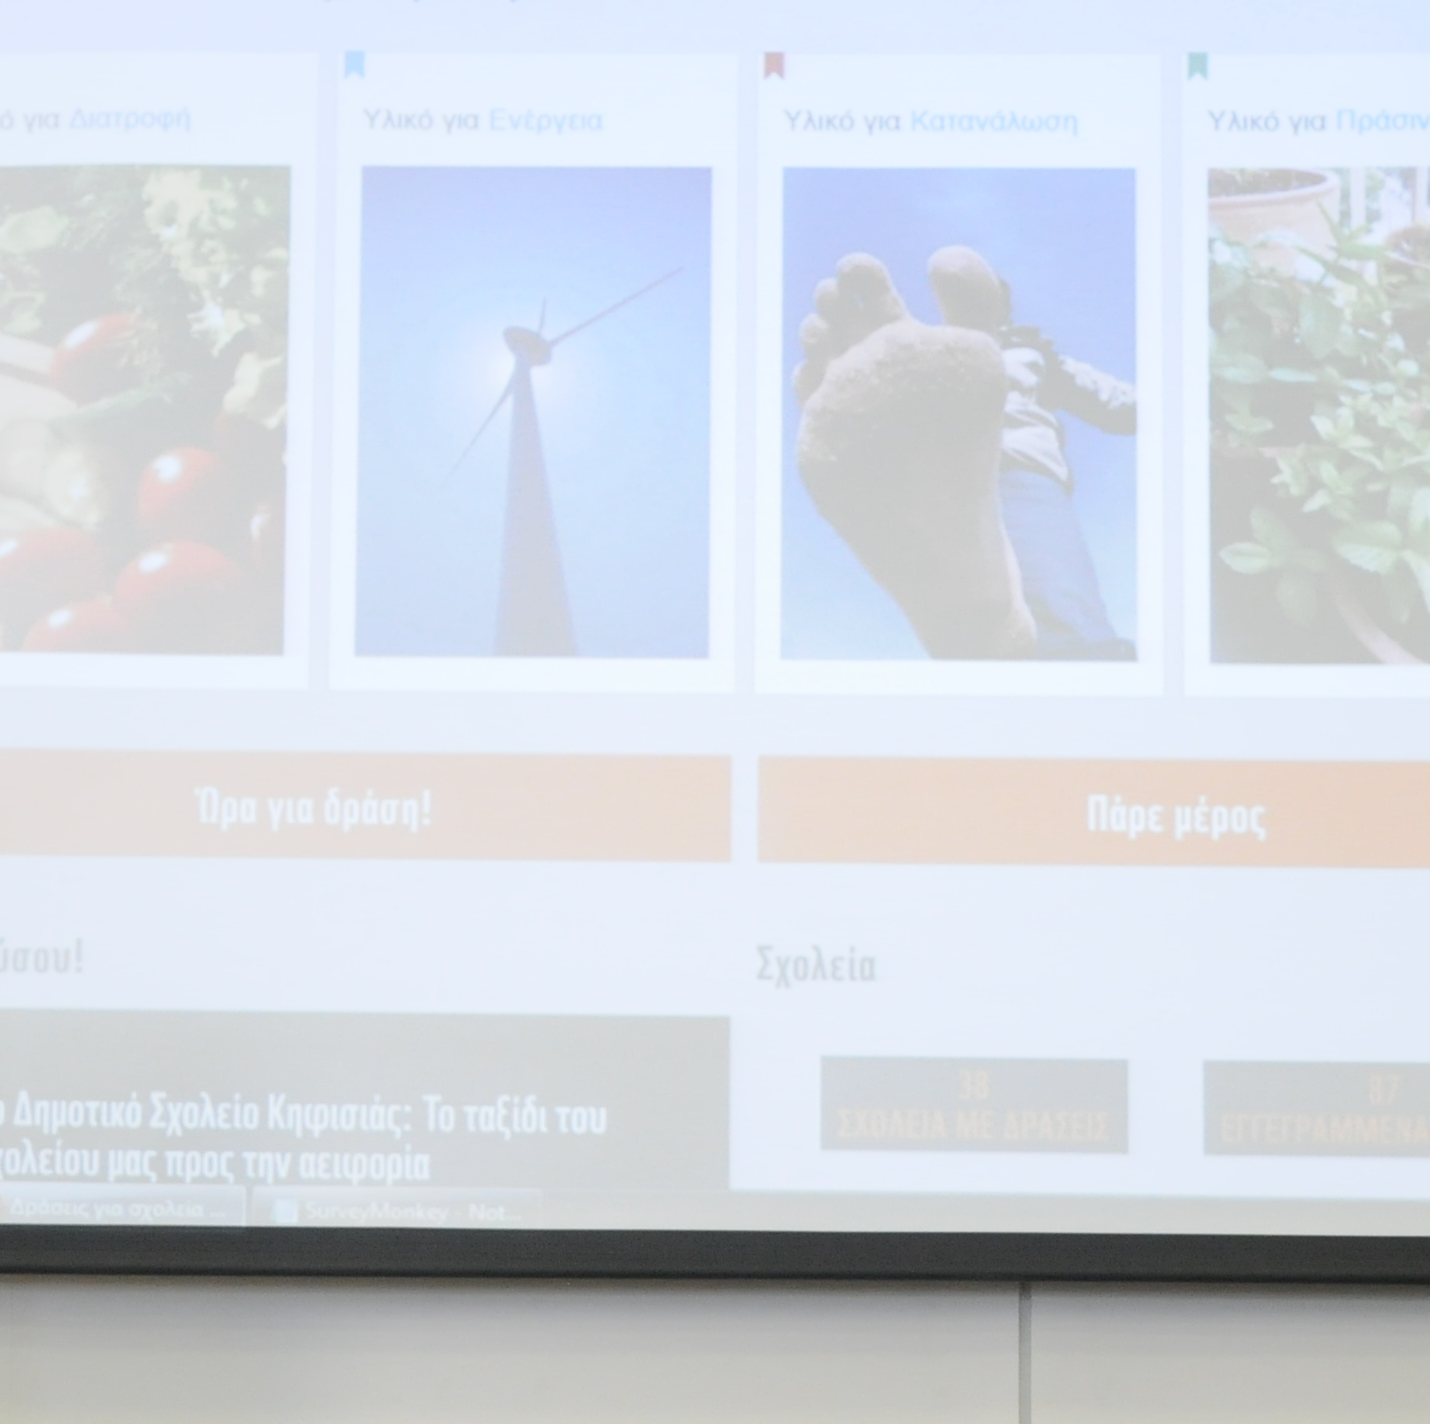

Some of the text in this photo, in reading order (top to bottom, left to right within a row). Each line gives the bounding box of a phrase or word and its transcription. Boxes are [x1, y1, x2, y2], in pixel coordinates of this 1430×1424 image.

[22, 112, 60, 134] για
[68, 107, 192, 133] Διατροφή
[362, 108, 603, 135] Υλικό για Ενέργεια
[783, 109, 1078, 136] Υλικό για Κατανάλωση
[1208, 109, 1279, 132] Υλικό
[1288, 114, 1326, 136] για
[194, 786, 431, 833] Ώρα για δράση!
[1087, 793, 1266, 842] Πάρε μέρος
[756, 944, 876, 989] Σχολεία
[13, 1088, 141, 1134] Δημοτικό
[149, 1091, 259, 1136] Σχολείο
[268, 1092, 411, 1137] Κηφισιάς:
[422, 1094, 455, 1131] Το
[465, 1093, 549, 1140] ταξίδι
[556, 1104, 608, 1135] του
[838, 1108, 1110, 1142] ΣΧΟΛΕΙΑ ΜΕ ΔΡΑΣΕΙΣ
[1221, 1112, 1429, 1144] ΕΓΓΕΓΡΑΜΜΕΝΑ
[109, 1150, 157, 1181] μας
[166, 1148, 235, 1183] προς
[243, 1149, 292, 1185] την
[300, 1144, 430, 1184] αειφορία
[94, 1204, 122, 1220] για
[129, 1199, 204, 1220] σχολεία
[306, 1200, 449, 1223] SurveyMonkey
